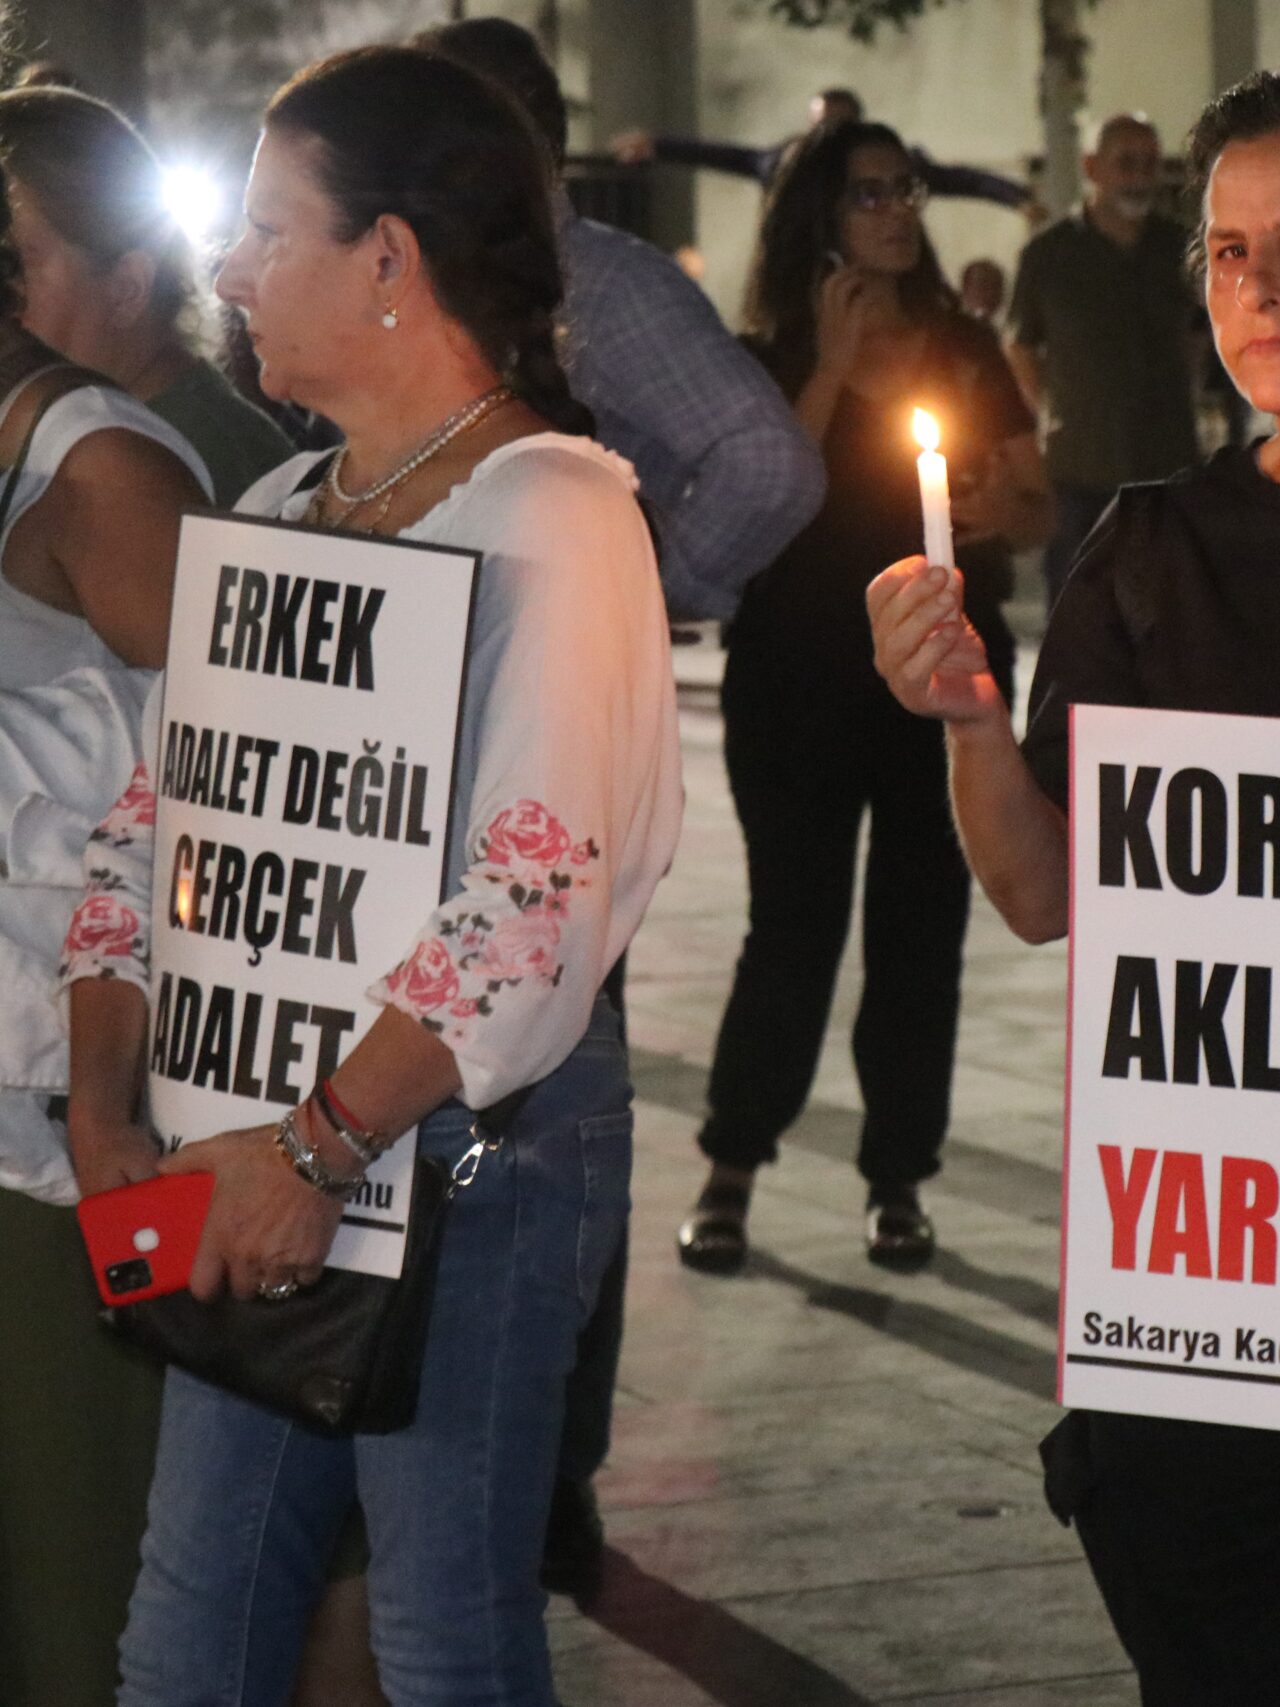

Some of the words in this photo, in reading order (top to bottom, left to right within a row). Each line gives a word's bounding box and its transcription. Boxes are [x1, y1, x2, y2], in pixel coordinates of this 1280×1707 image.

[207, 564, 386, 692] ERKEK
[161, 720, 281, 818] ADALET
[282, 738, 432, 847] DEĞİL
[151, 970, 356, 1106] ADALET
[1083, 1311, 1221, 1363] Sakarya
